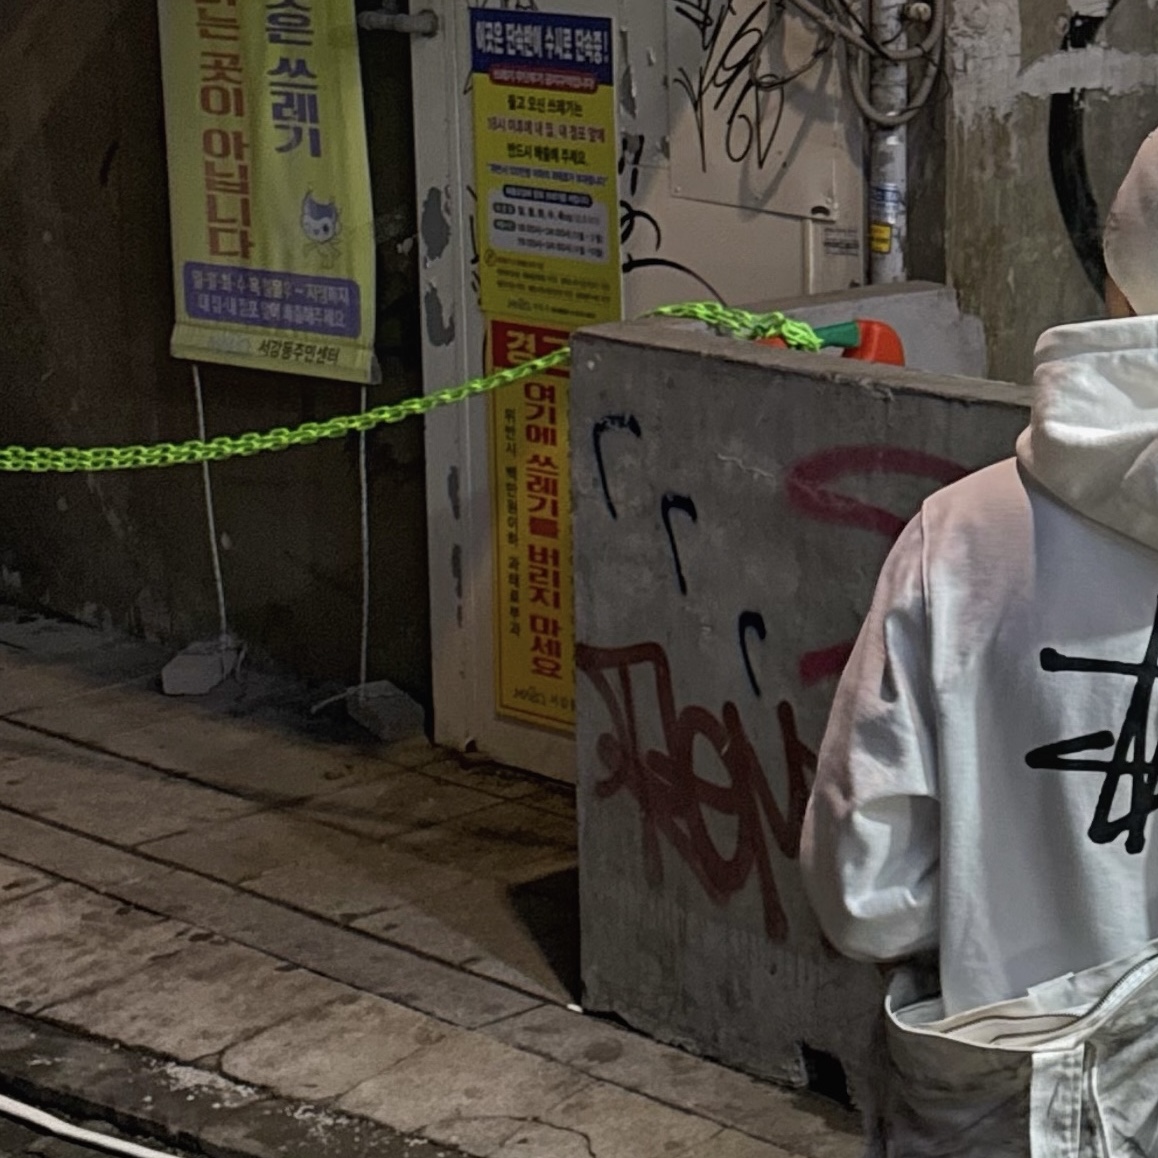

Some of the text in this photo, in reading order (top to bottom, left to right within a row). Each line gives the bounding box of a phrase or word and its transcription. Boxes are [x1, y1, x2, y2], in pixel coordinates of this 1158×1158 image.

[476, 21, 503, 54] 이곳은
[545, 26, 573, 60] 수시로
[575, 29, 609, 64] 단속중!
[199, 51, 244, 117] 꽃이
[266, 57, 322, 158] 쓰레기
[203, 129, 254, 259] 아닙니다
[258, 339, 341, 365] 서강동주민센터
[524, 382, 558, 447] 여기에
[525, 454, 559, 539] 쓰레기를
[528, 543, 561, 610] 버리지
[529, 614, 563, 680] 마세요
